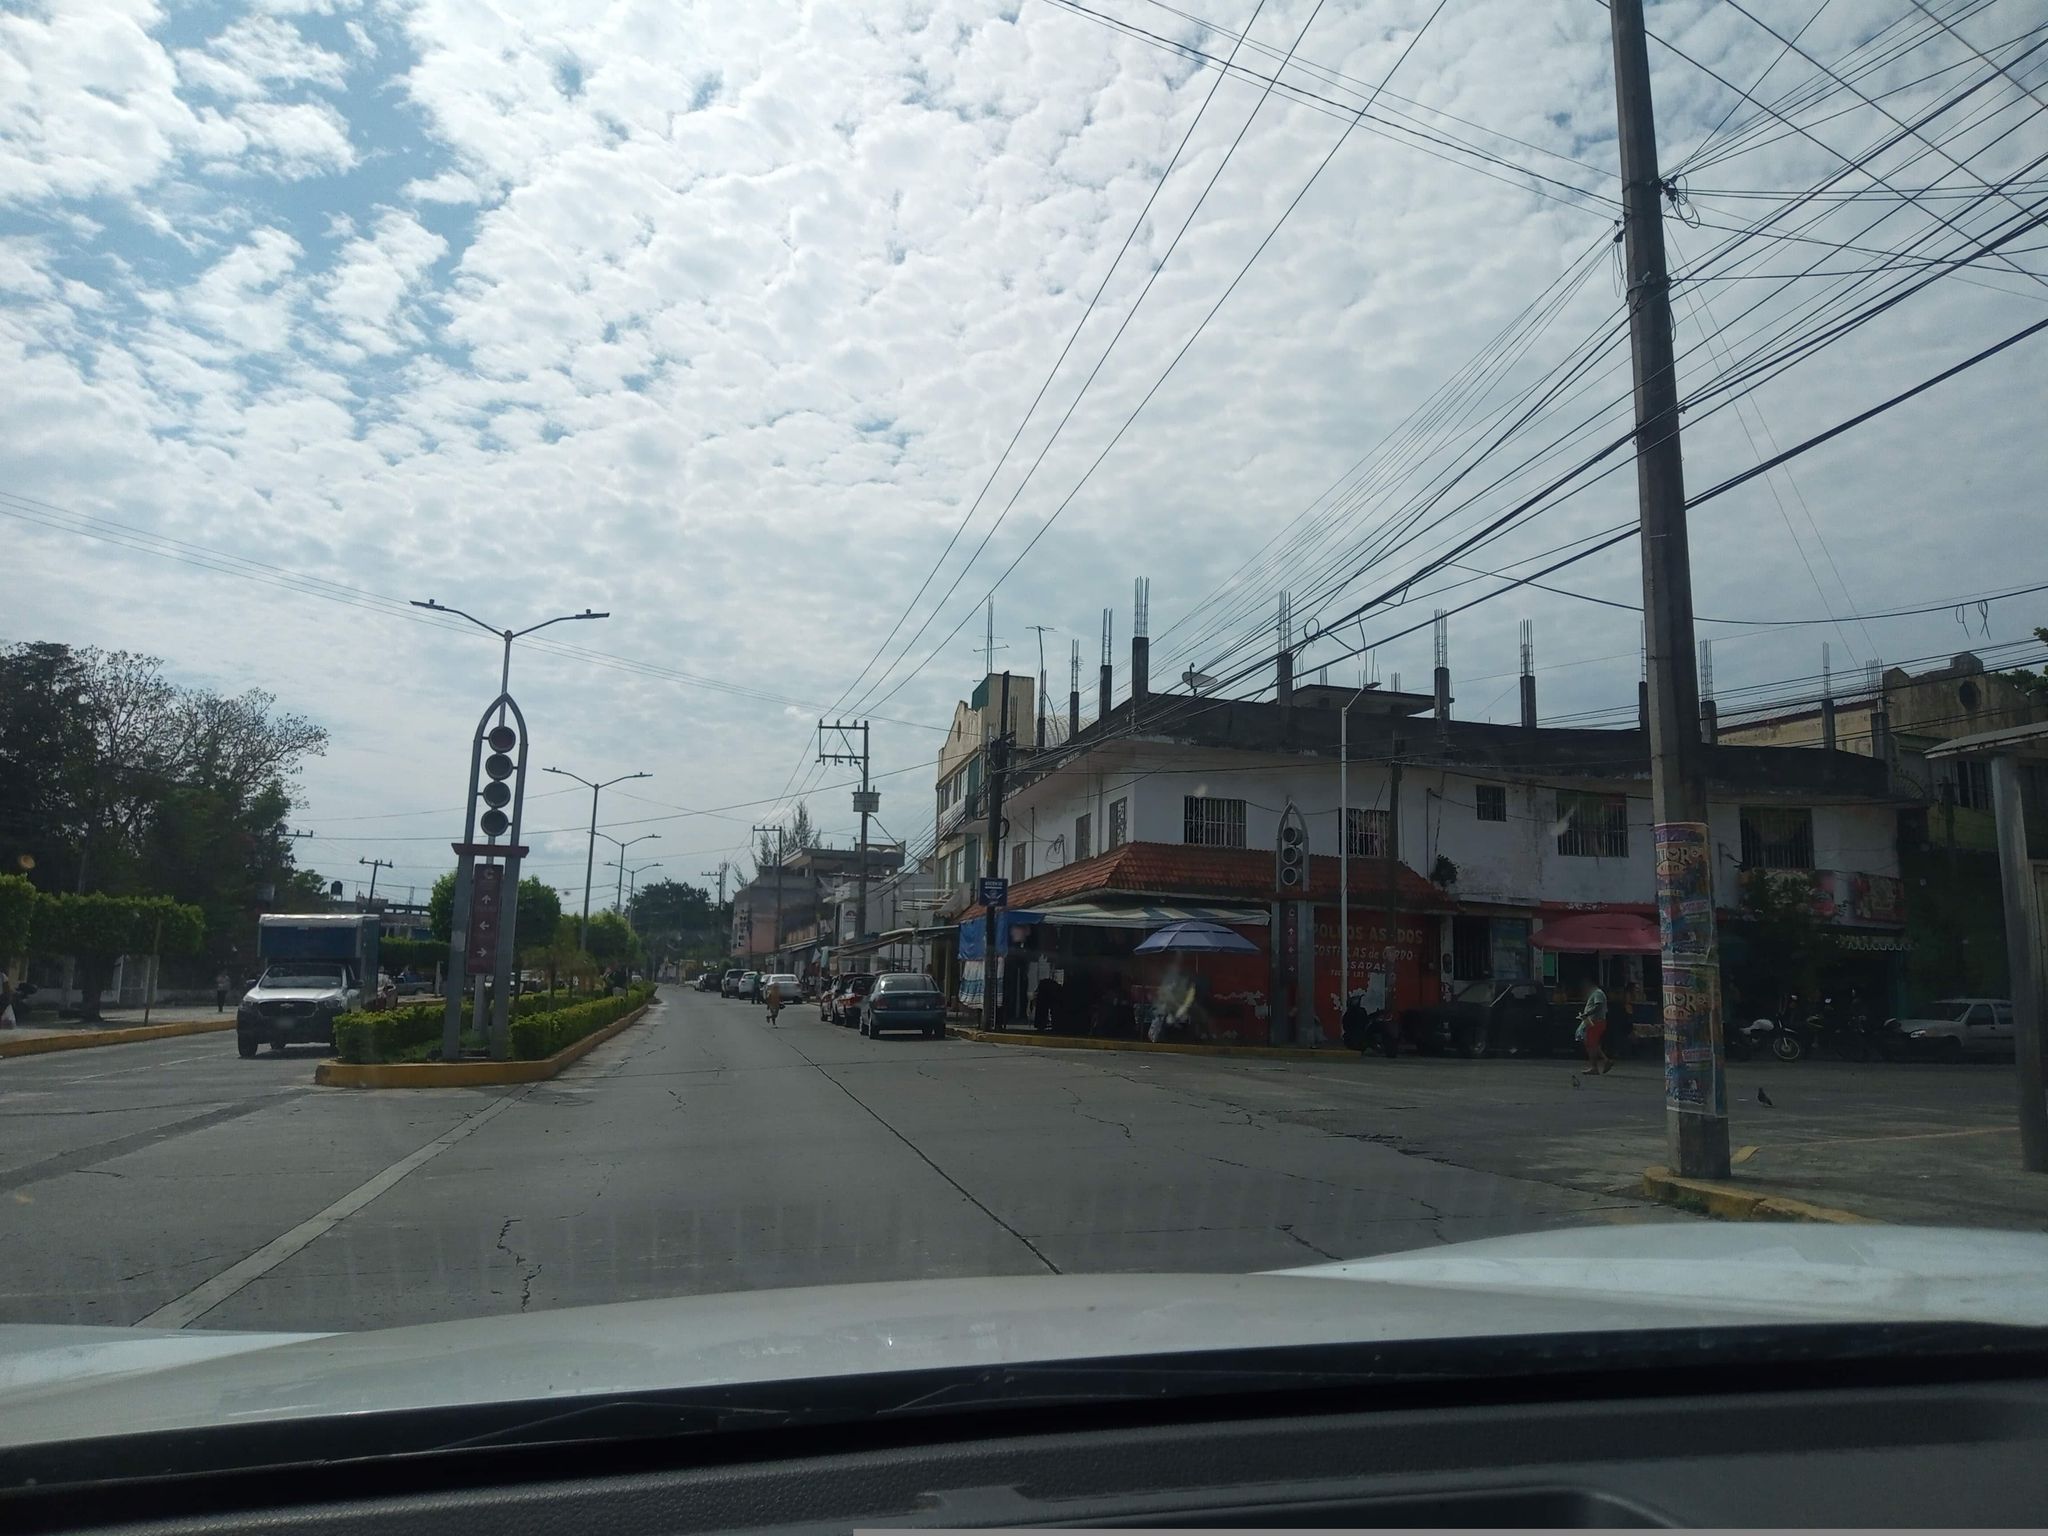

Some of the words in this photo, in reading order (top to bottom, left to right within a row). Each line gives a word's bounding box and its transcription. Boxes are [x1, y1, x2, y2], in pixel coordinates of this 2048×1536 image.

[1370, 926, 1423, 944] ASDOS
[1313, 945, 1367, 959] COSTILAS
[1349, 961, 1386, 971] SADAS
